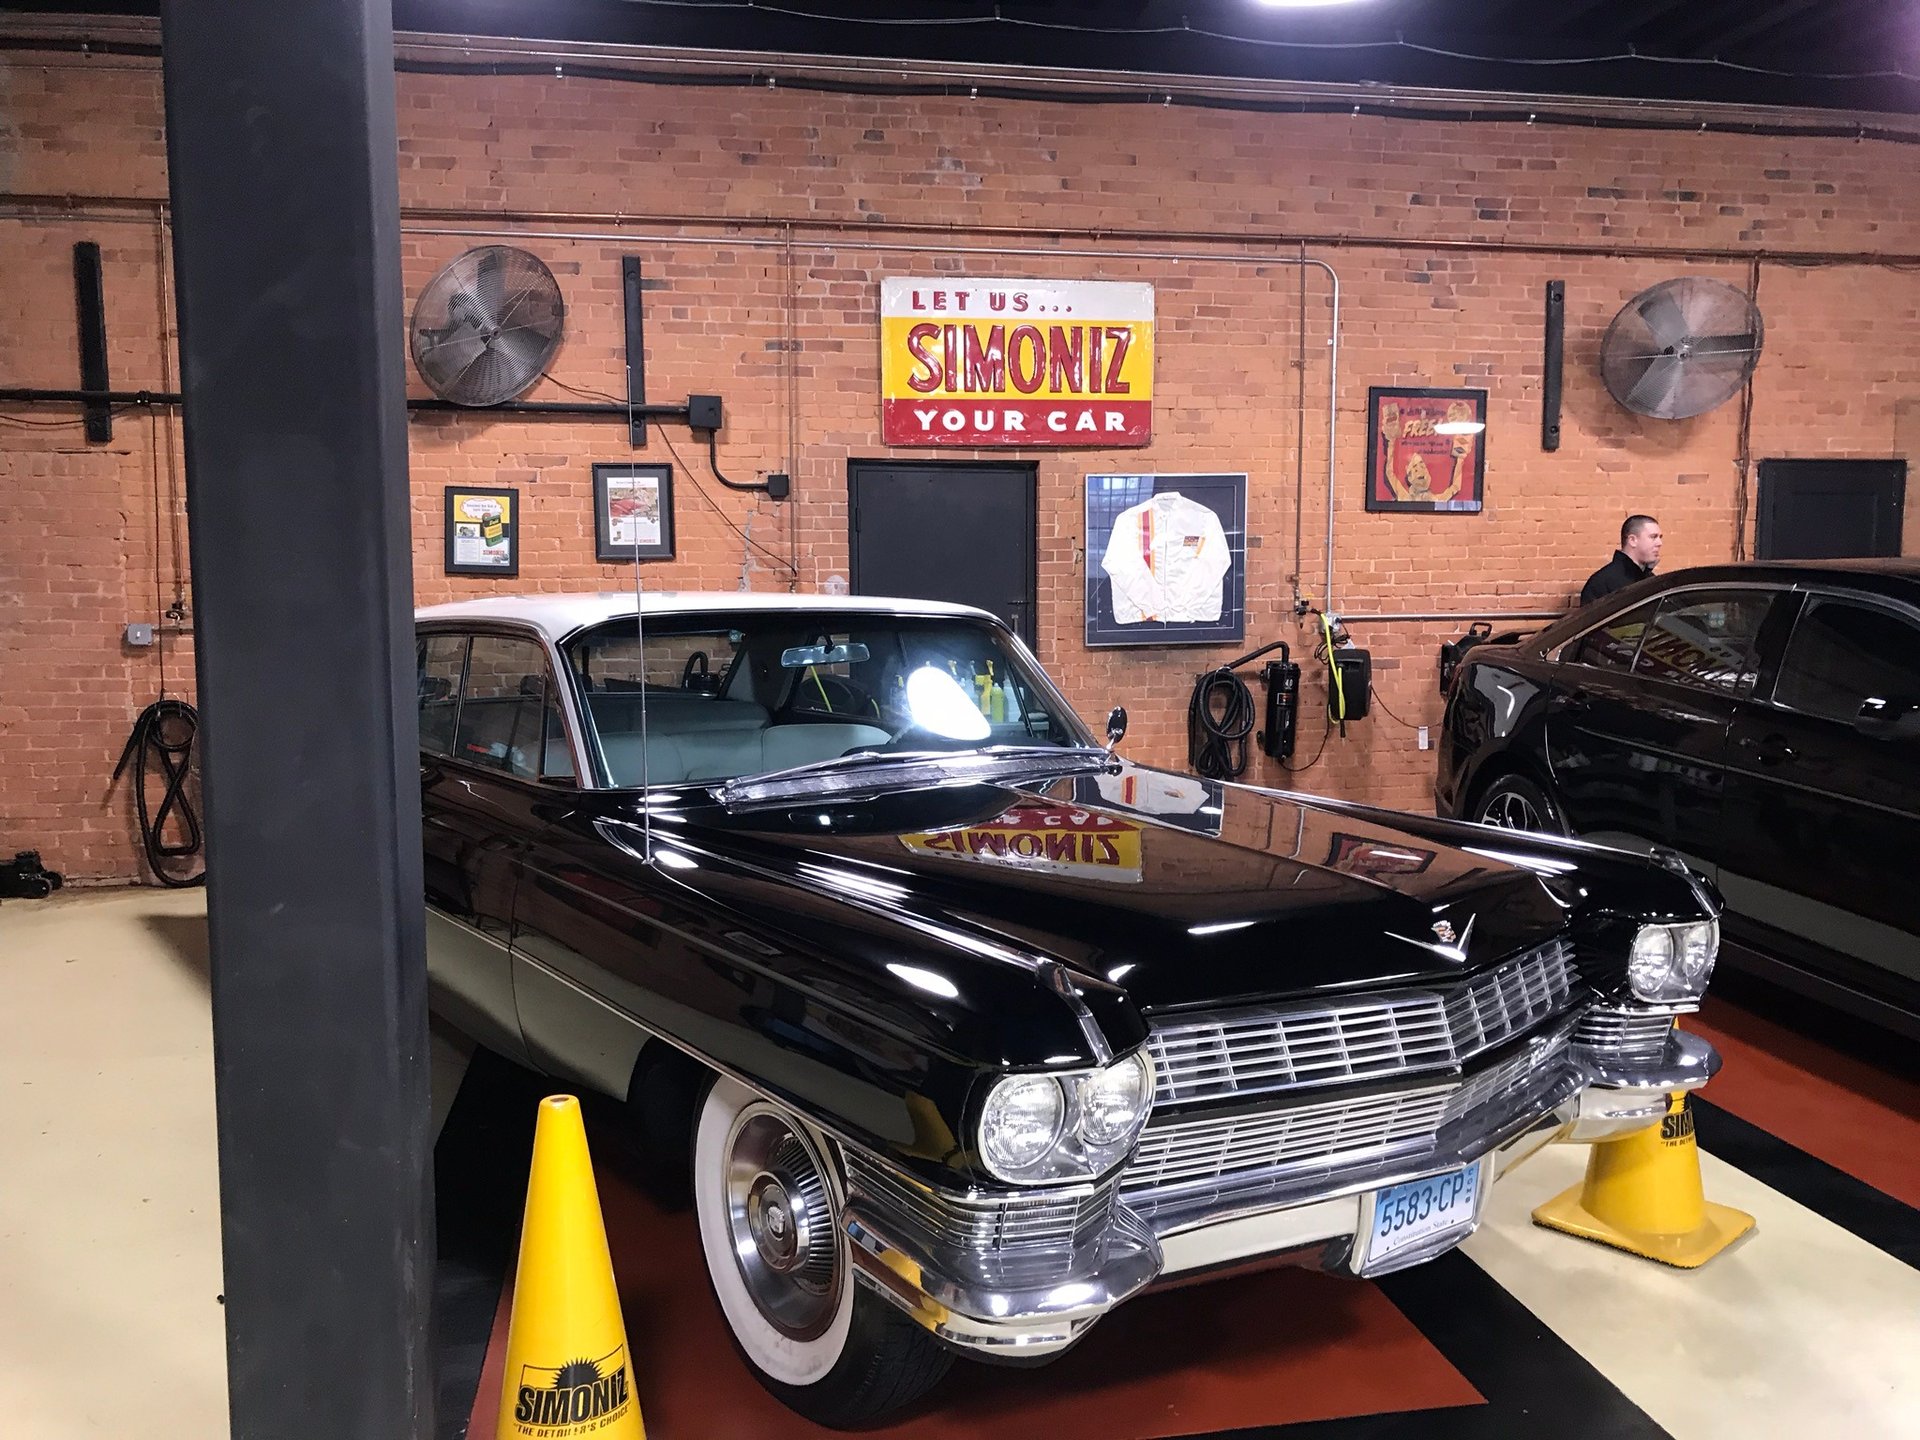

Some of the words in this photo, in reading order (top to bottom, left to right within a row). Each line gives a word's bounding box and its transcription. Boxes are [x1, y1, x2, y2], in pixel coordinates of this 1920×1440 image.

[912, 291, 970, 311] LET
[989, 291, 1073, 312] US...
[907, 322, 1132, 394] SIMONIZ
[913, 409, 1025, 432] YOUR
[1047, 407, 1126, 432] CAR
[515, 1367, 629, 1426] SIMONIZ
